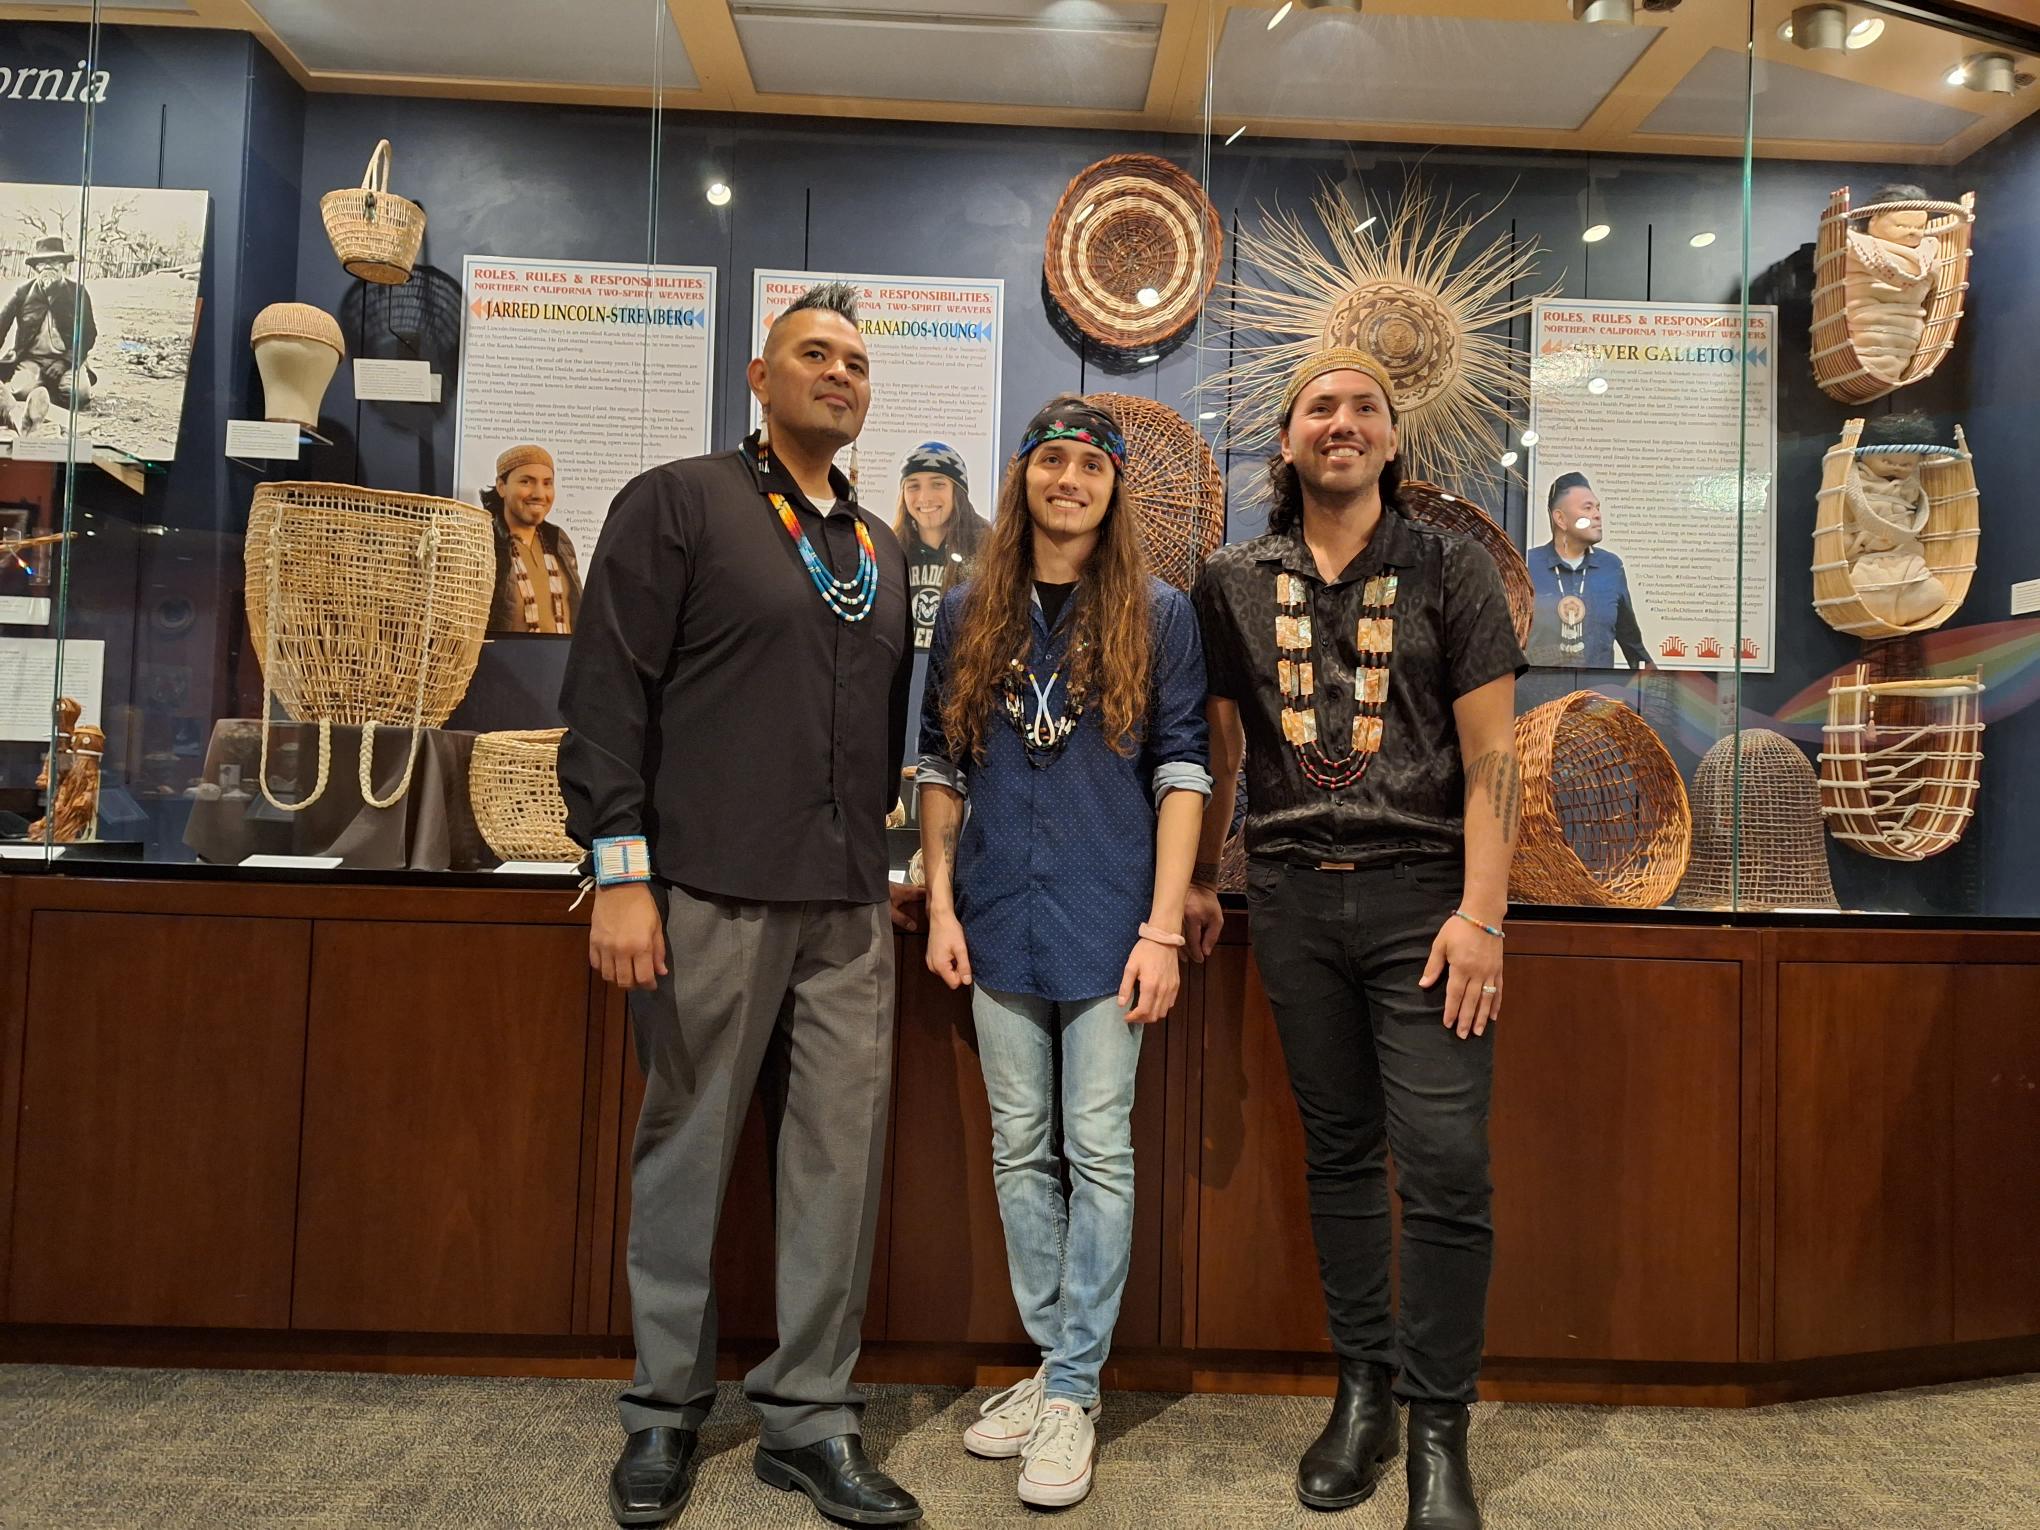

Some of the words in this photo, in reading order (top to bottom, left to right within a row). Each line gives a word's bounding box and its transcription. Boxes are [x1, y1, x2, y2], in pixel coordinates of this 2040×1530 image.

[526, 272, 567, 282] RULES
[573, 274, 583, 283] &
[474, 282, 528, 292] NORTHERN
[533, 285, 592, 296] CALIFORNIA
[598, 288, 653, 299] TWO-SPIRIT
[659, 291, 704, 300] WEAVERS
[864, 289, 873, 298] &
[880, 289, 992, 303] RESPONSIBILITIES:
[485, 301, 540, 320] JARRED
[543, 304, 694, 326] LINCOLN-STREMBERG
[887, 303, 943, 312] TWO-SPIRIT
[947, 305, 992, 314] WEAVERS
[1592, 314, 1632, 324] RULES
[1638, 315, 1648, 325] &
[858, 319, 977, 339] GRANADOS-YOUNG
[1544, 325, 1595, 334] NORTHERN
[1600, 327, 1656, 336] CALIFORNIA
[1662, 329, 1716, 338] TWO-SPIRIT
[1721, 330, 1767, 339] WEAERS
[1645, 346, 1734, 363] GALLETO
